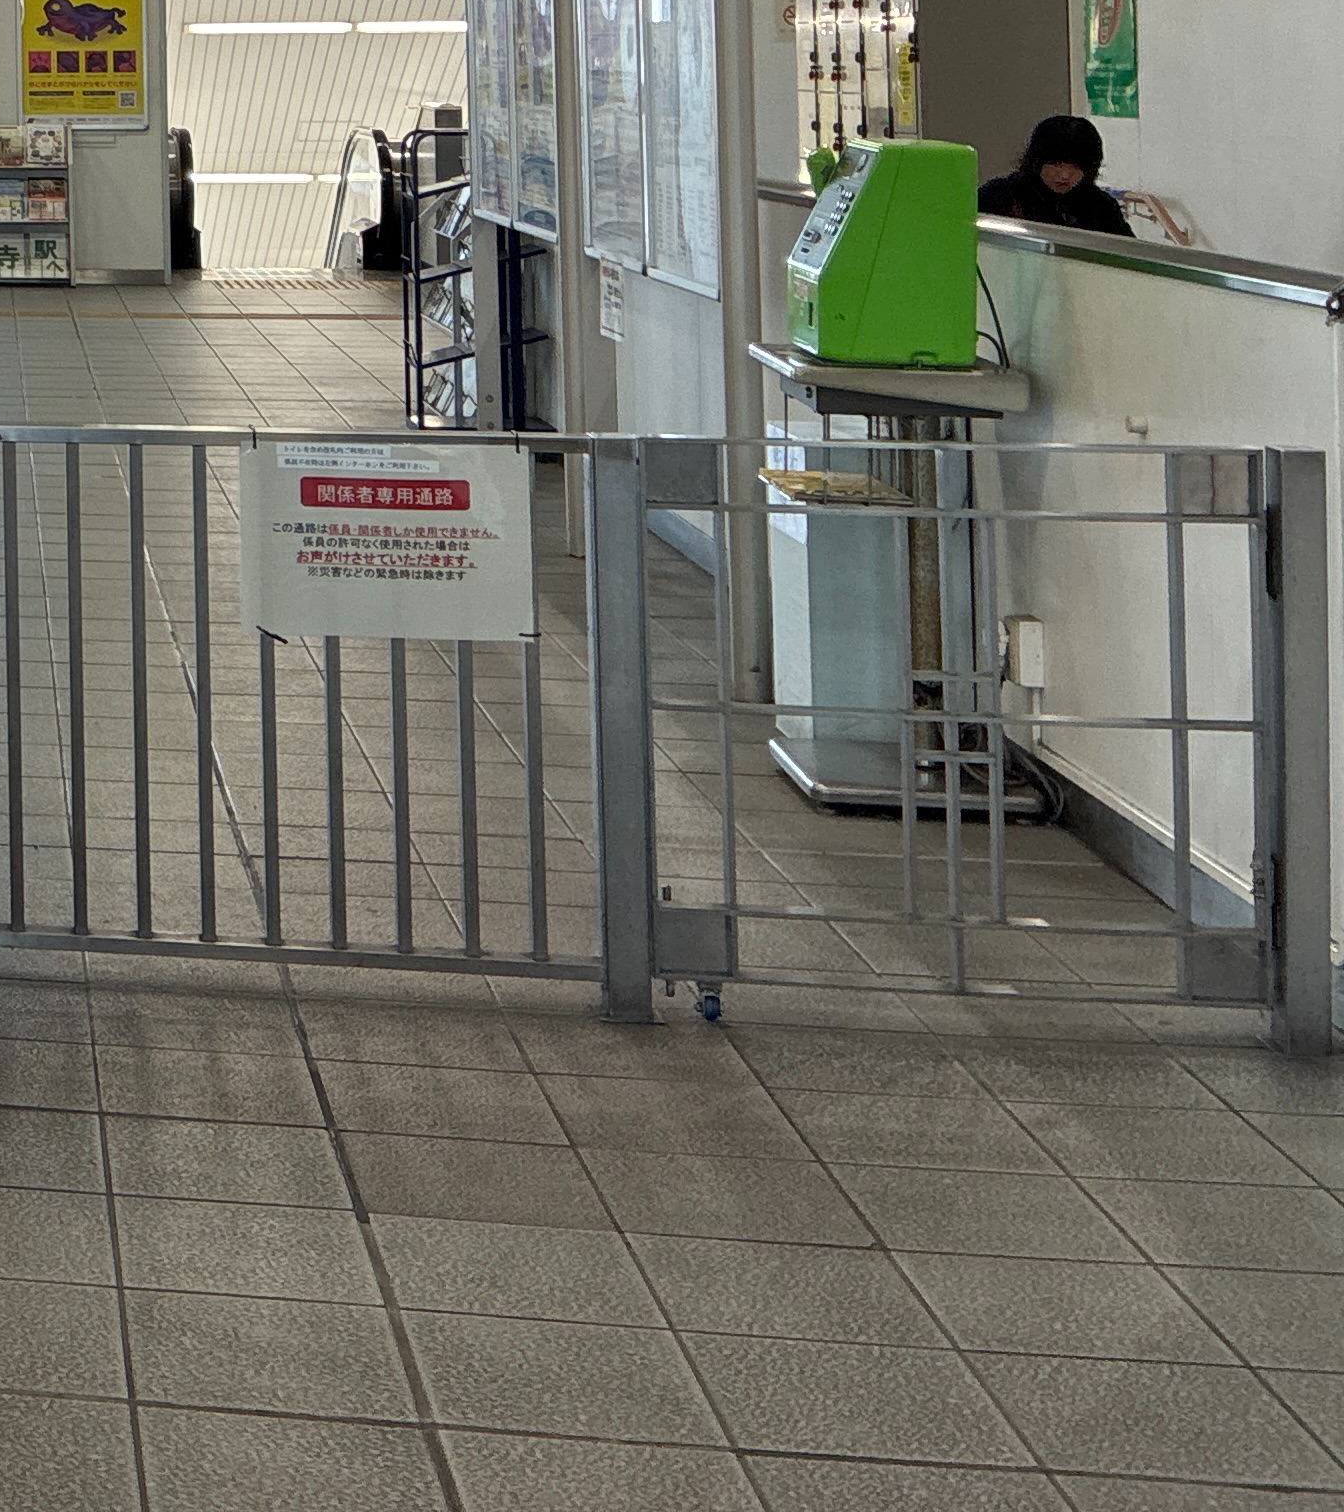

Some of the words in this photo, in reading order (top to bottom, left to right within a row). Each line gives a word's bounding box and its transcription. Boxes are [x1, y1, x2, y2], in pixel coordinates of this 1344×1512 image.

[317, 484, 454, 506] 関係者専用通路
[302, 537, 471, 552] 係員の許可なく使用された場合は
[296, 550, 476, 568] お声がけさせていただきます。
